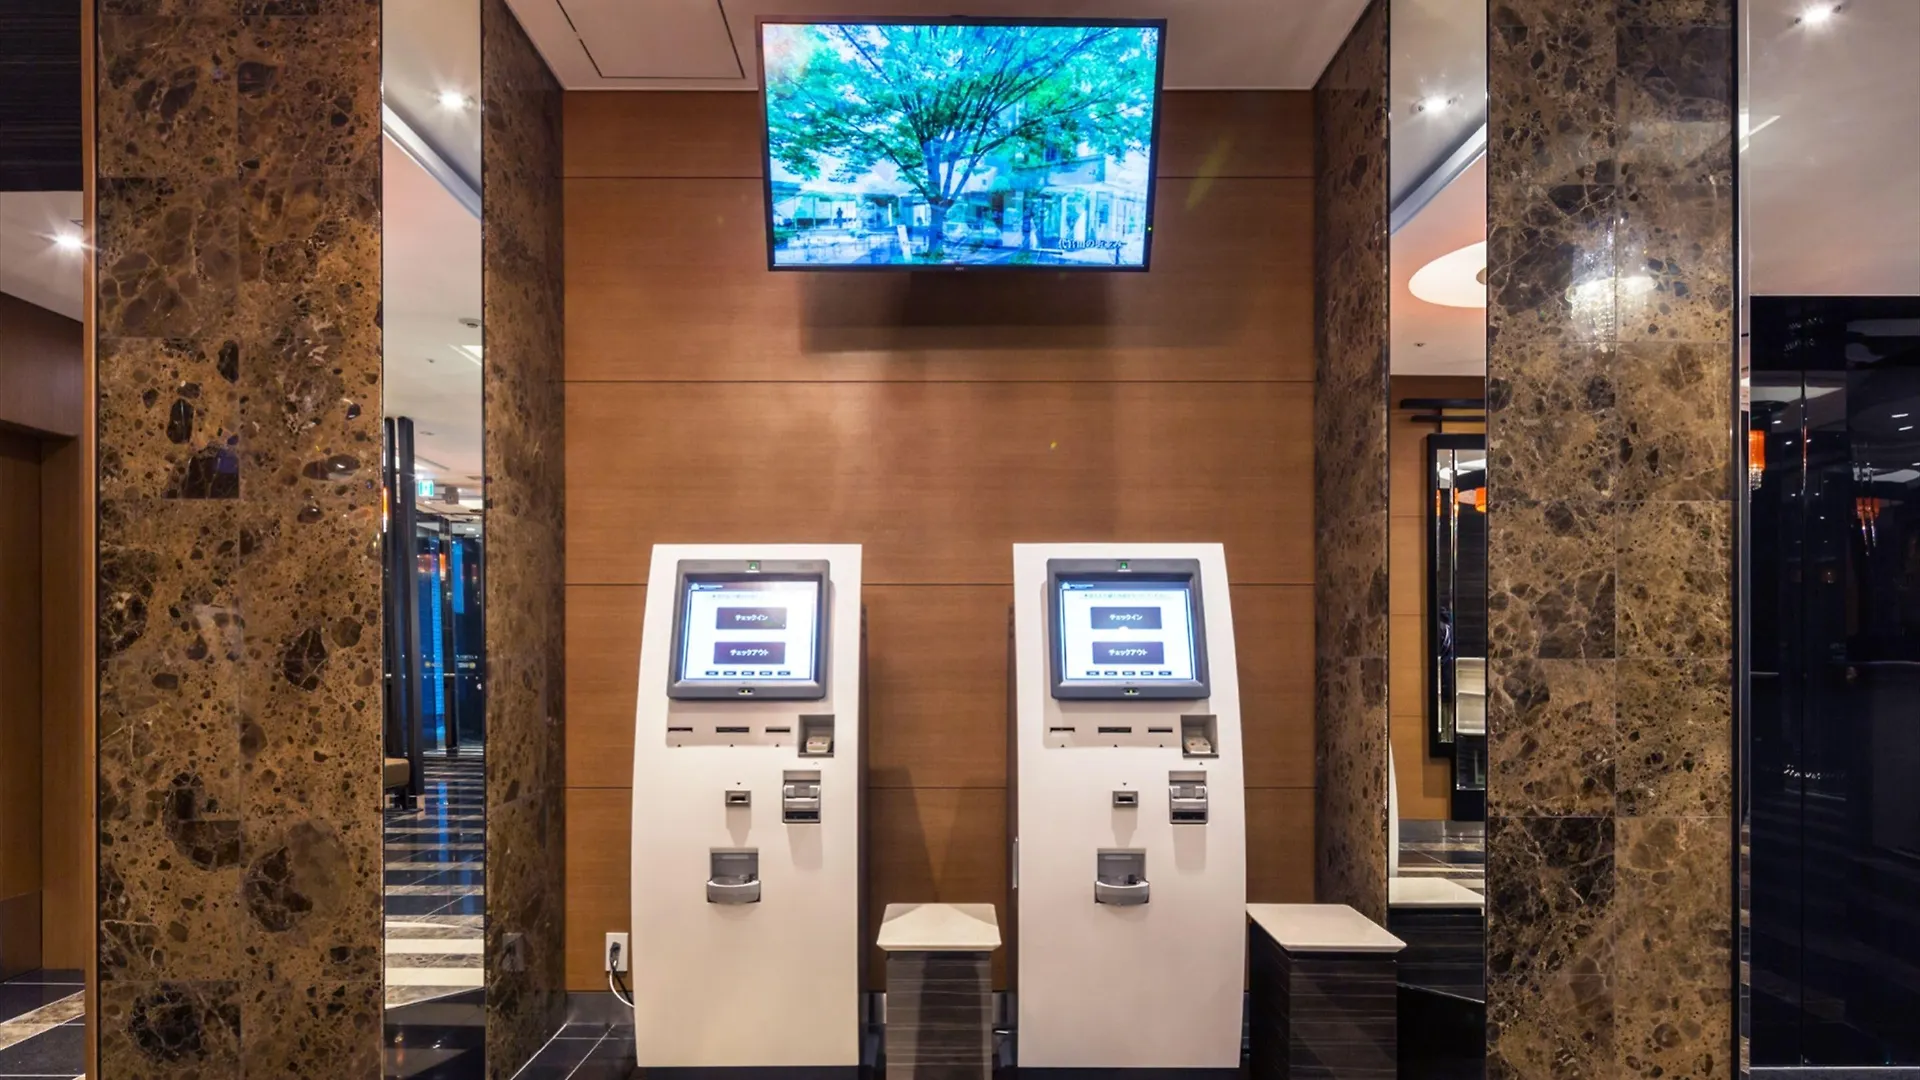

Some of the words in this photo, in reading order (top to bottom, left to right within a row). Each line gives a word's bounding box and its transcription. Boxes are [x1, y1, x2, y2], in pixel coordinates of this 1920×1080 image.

[730, 649, 769, 657] チェックアウト
[1108, 648, 1147, 657] チェックアウト
